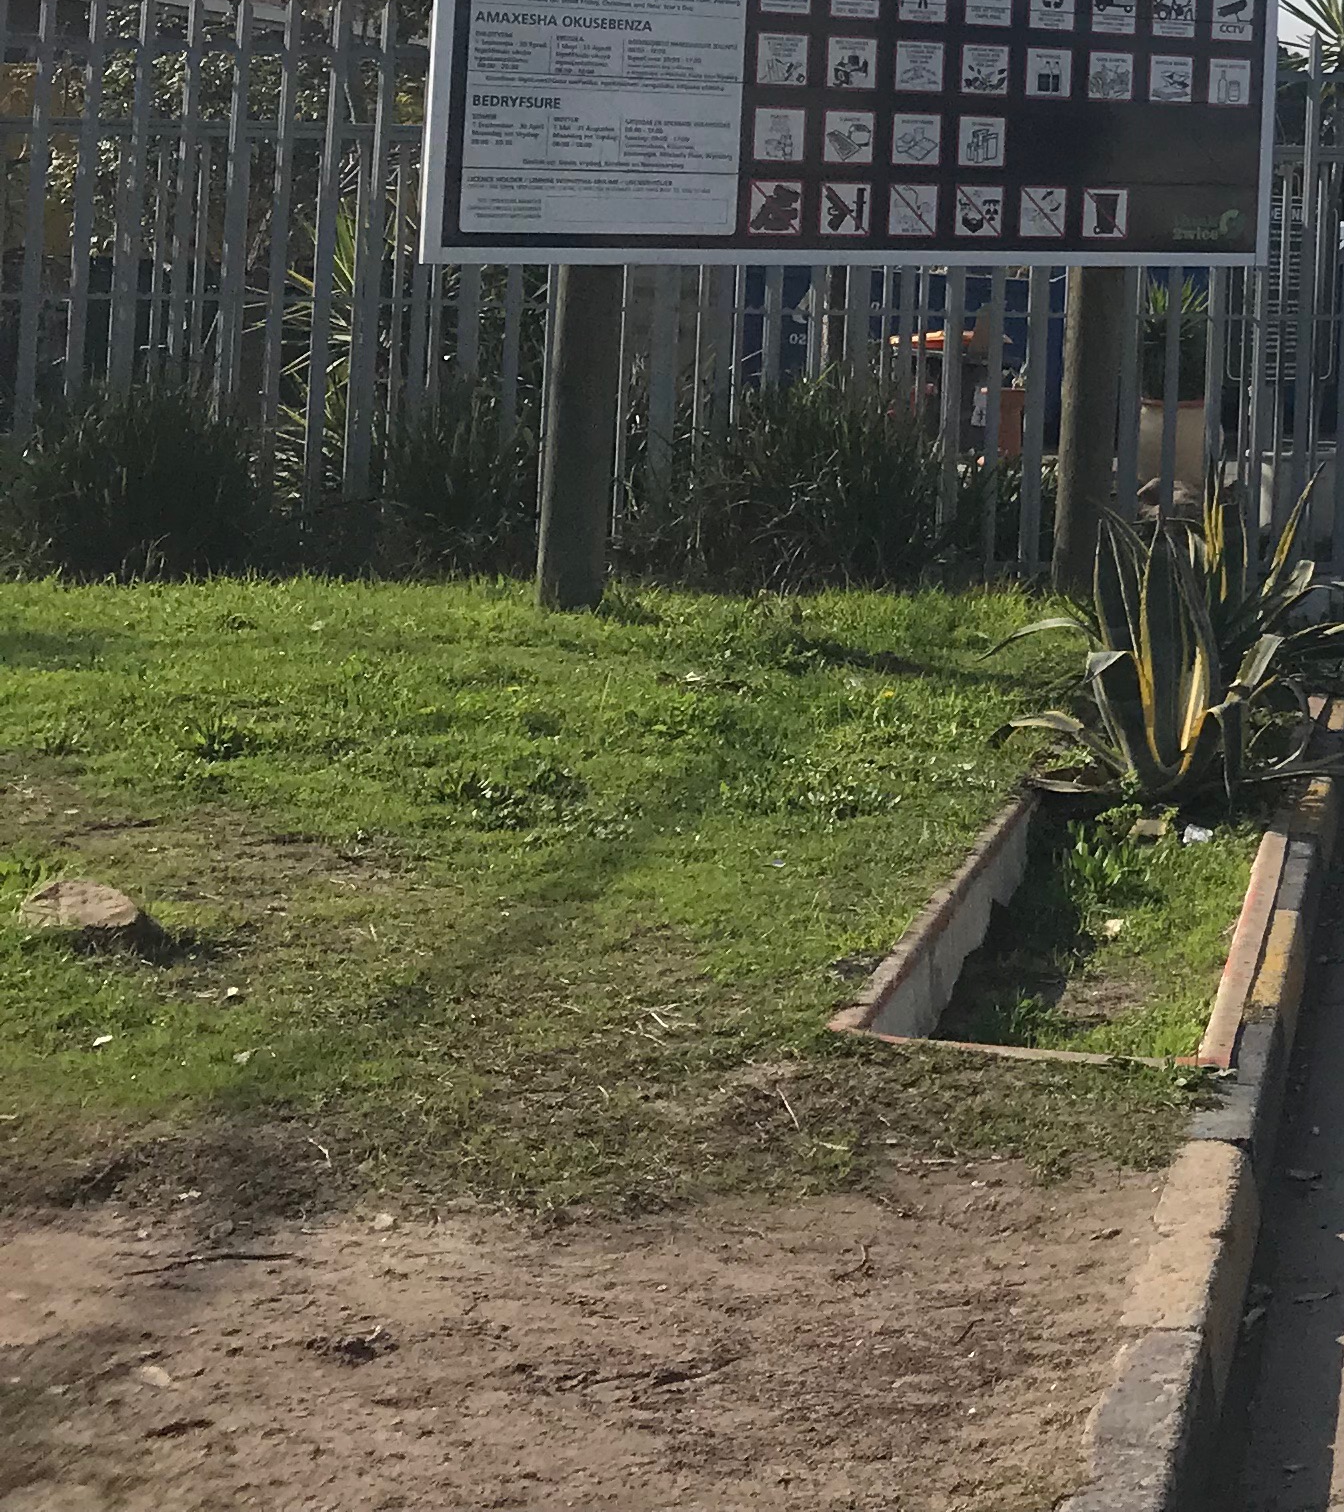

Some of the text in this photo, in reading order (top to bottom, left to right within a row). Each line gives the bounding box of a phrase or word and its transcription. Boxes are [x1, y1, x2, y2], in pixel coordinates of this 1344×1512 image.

[475, 10, 653, 33] AMAXESHA OKUSEBENZA
[1219, 23, 1246, 34] CCTV
[472, 94, 561, 110] BEDRYFSURE
